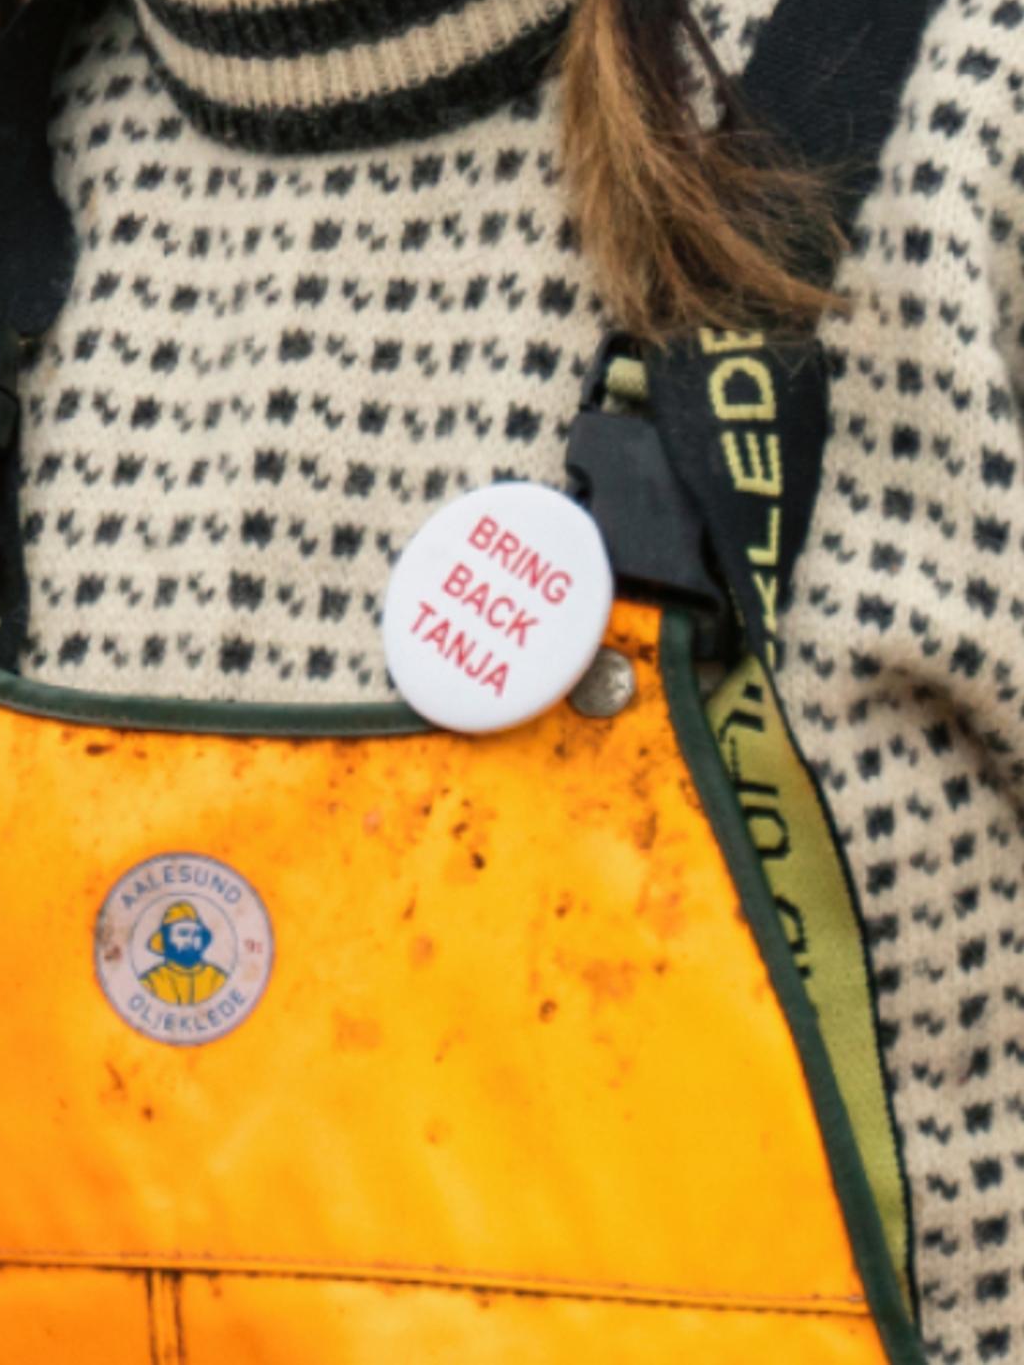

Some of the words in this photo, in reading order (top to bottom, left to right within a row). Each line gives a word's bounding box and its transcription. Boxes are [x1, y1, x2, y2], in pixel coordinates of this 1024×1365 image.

[467, 515, 573, 605] BRING
[409, 601, 510, 697] TANJA
[441, 563, 539, 648] BACK
